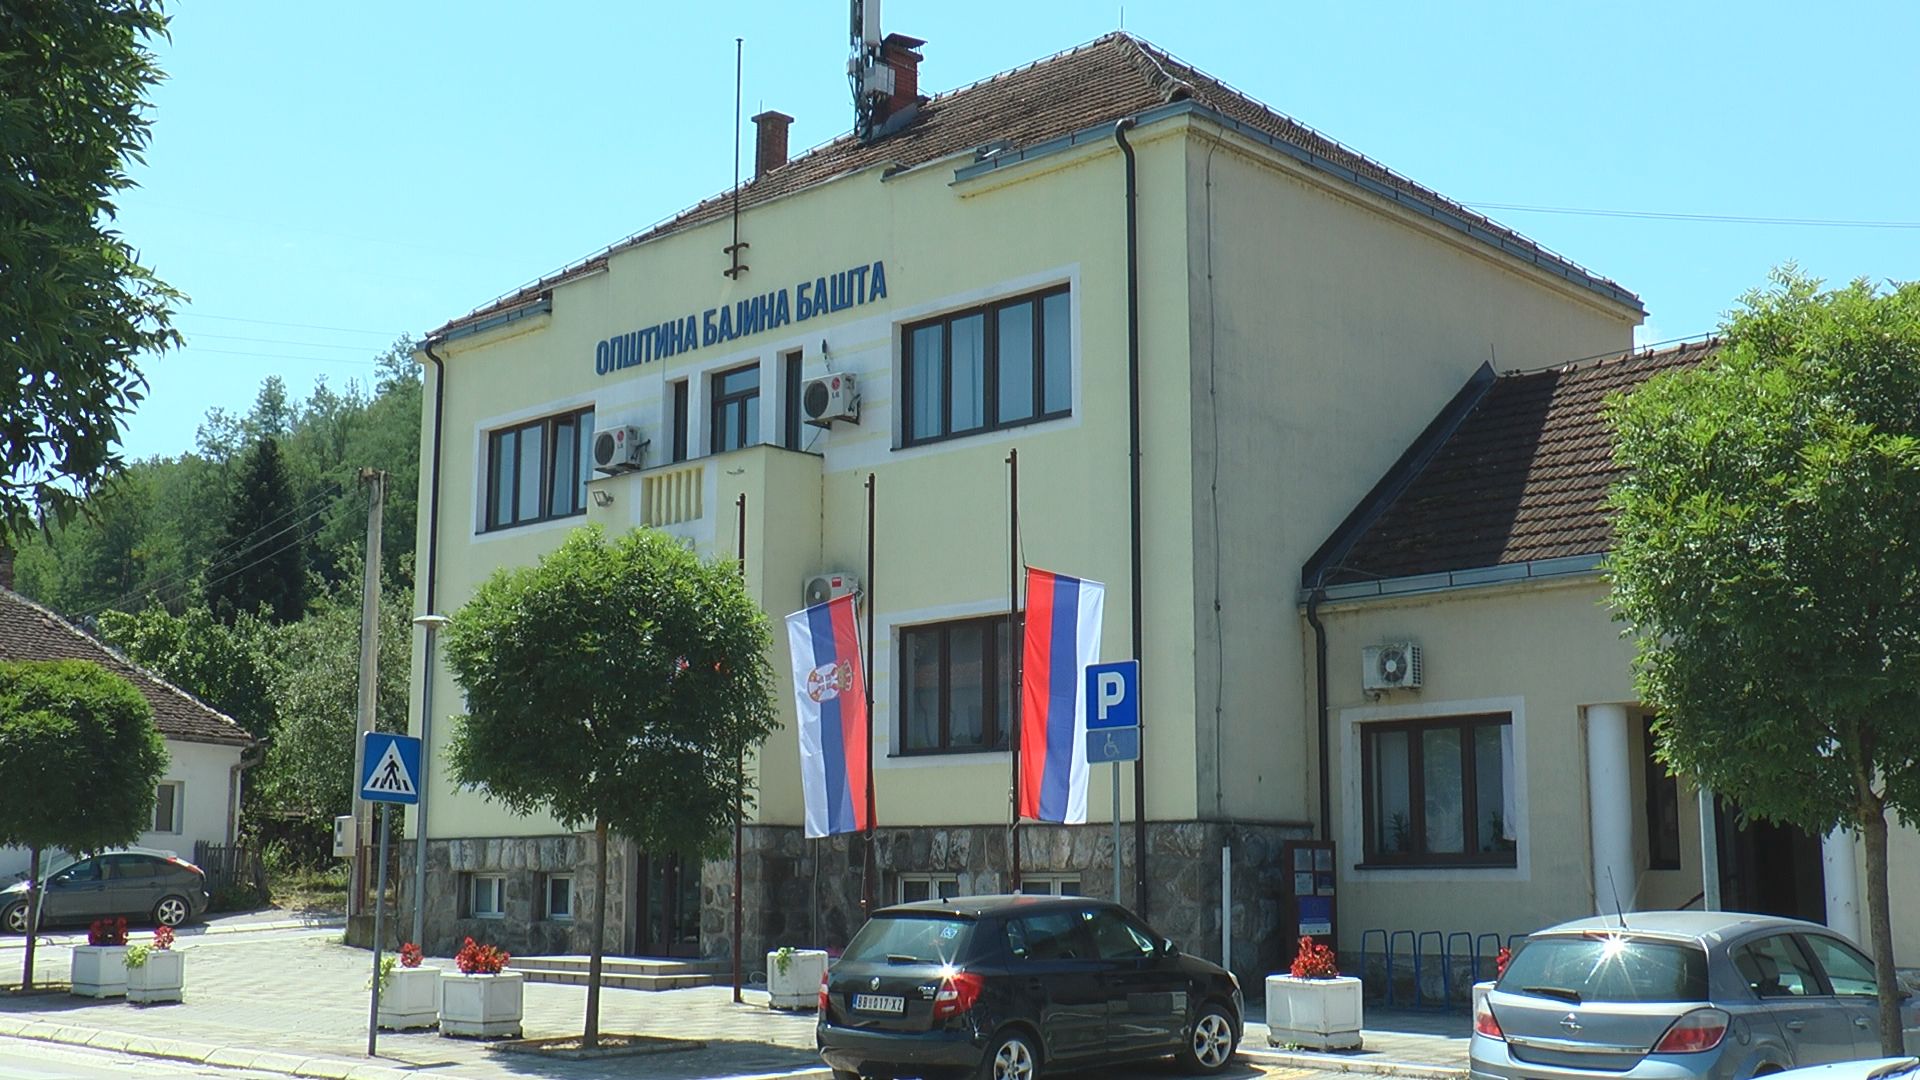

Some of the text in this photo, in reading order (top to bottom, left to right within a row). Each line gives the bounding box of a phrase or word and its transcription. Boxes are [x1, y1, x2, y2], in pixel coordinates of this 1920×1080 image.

[595, 260, 887, 375] ОПШТИНА БАЈИНА БАШТА
[1097, 671, 1125, 720] P
